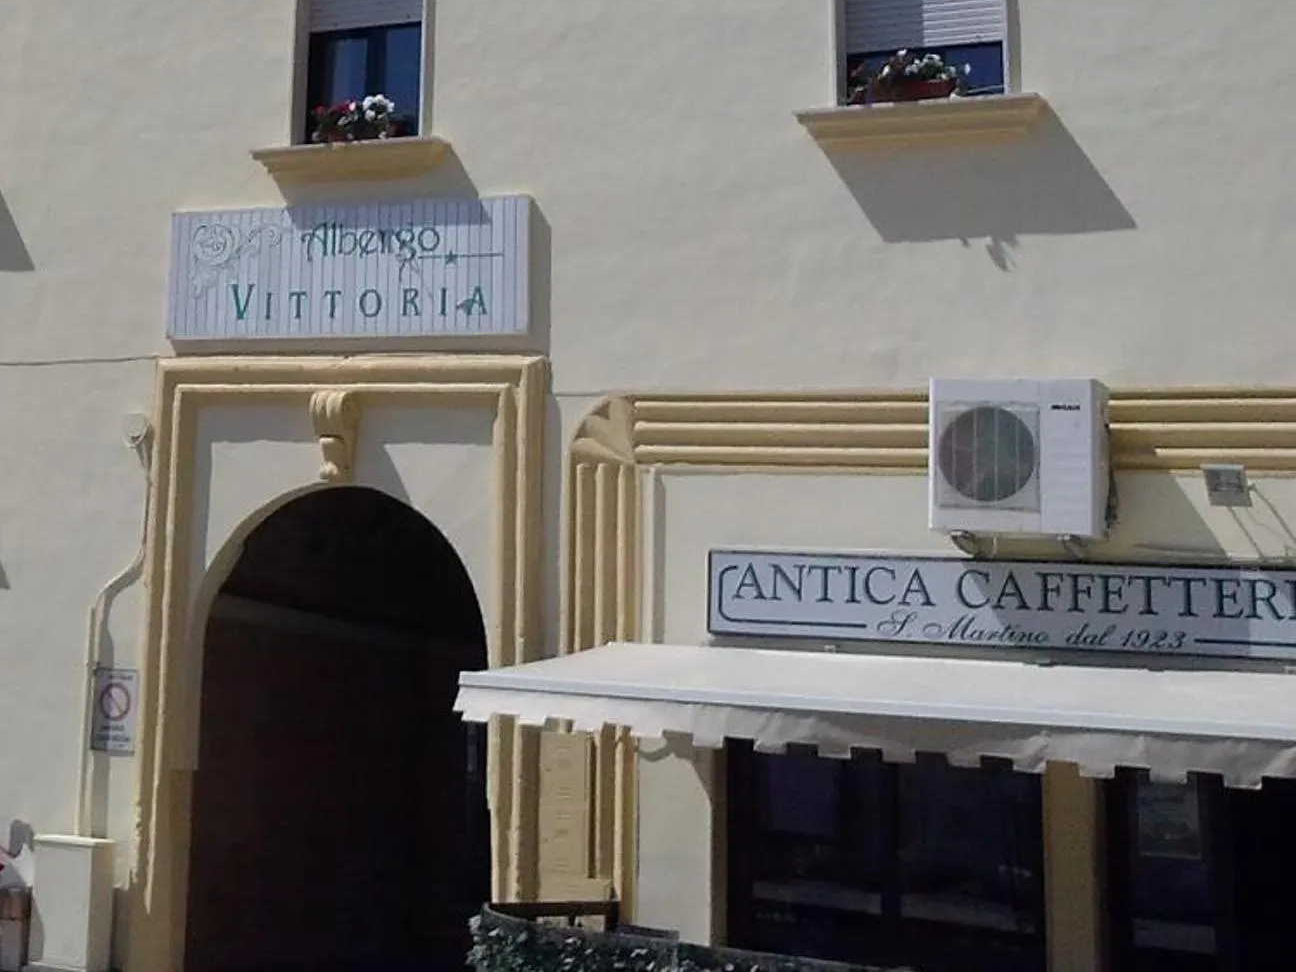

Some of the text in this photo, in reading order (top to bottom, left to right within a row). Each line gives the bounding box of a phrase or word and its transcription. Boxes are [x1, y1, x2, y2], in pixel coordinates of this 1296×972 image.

[301, 221, 440, 282] Albergo
[231, 283, 488, 321] VITTORIA
[731, 562, 936, 607] ANTICA
[922, 613, 1048, 644] Martino
[1065, 623, 1117, 647] dal
[1120, 628, 1187, 649] 1923
